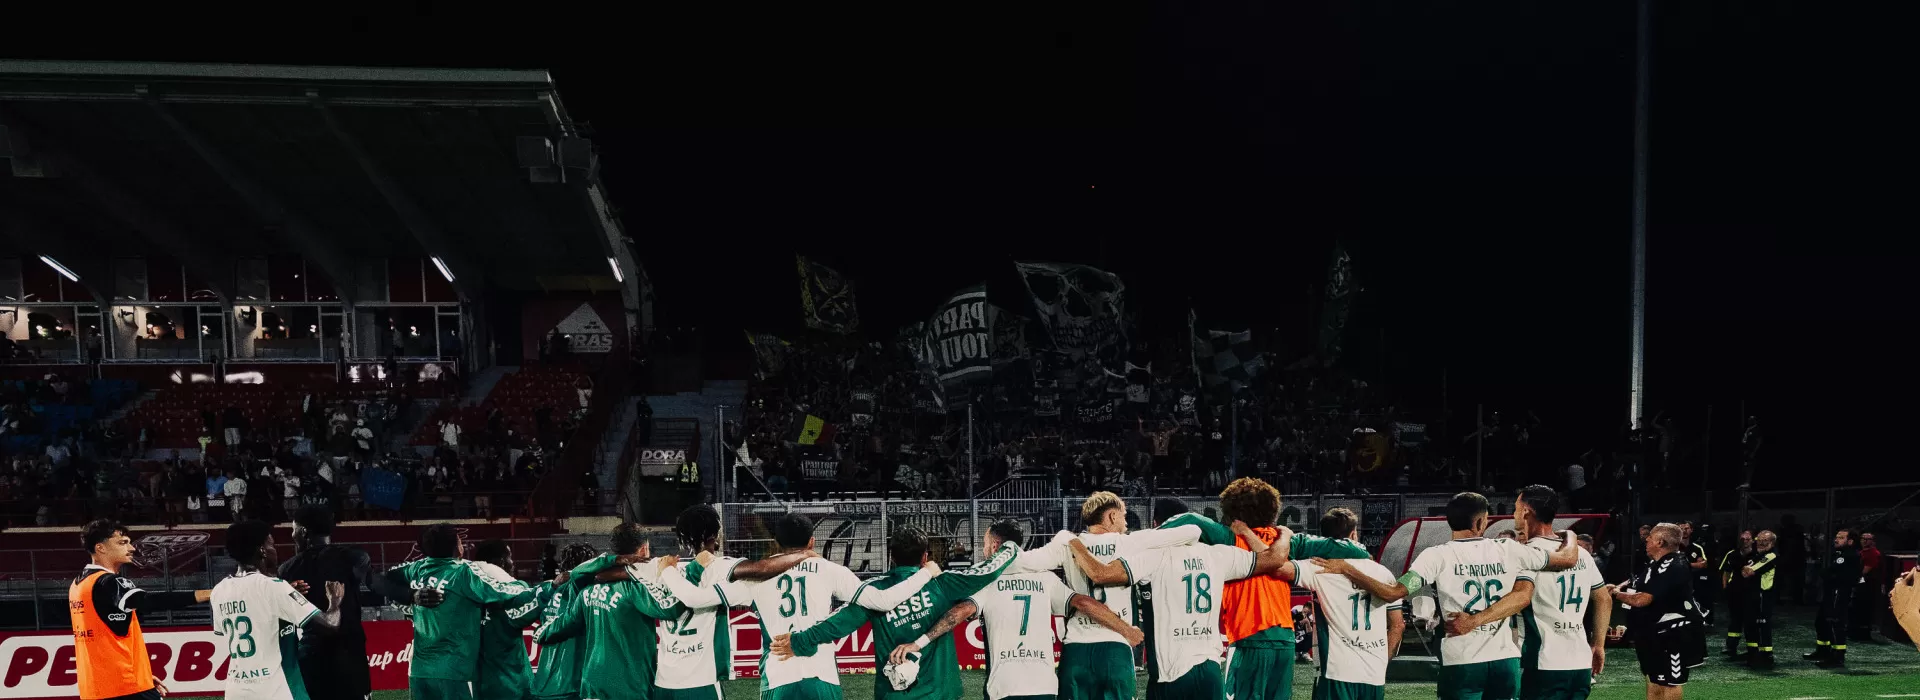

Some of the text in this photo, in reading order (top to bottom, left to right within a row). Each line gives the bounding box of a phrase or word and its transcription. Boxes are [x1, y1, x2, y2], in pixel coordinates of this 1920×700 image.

[776, 573, 809, 618] 31
[997, 579, 1045, 594] CARDONA
[1181, 572, 1212, 614] 18
[1463, 578, 1504, 615] 26
[1556, 573, 1583, 613] 14
[219, 600, 247, 617] PEDRO
[1012, 594, 1032, 636] 7
[1347, 593, 1372, 631] 11
[222, 616, 257, 659] 23
